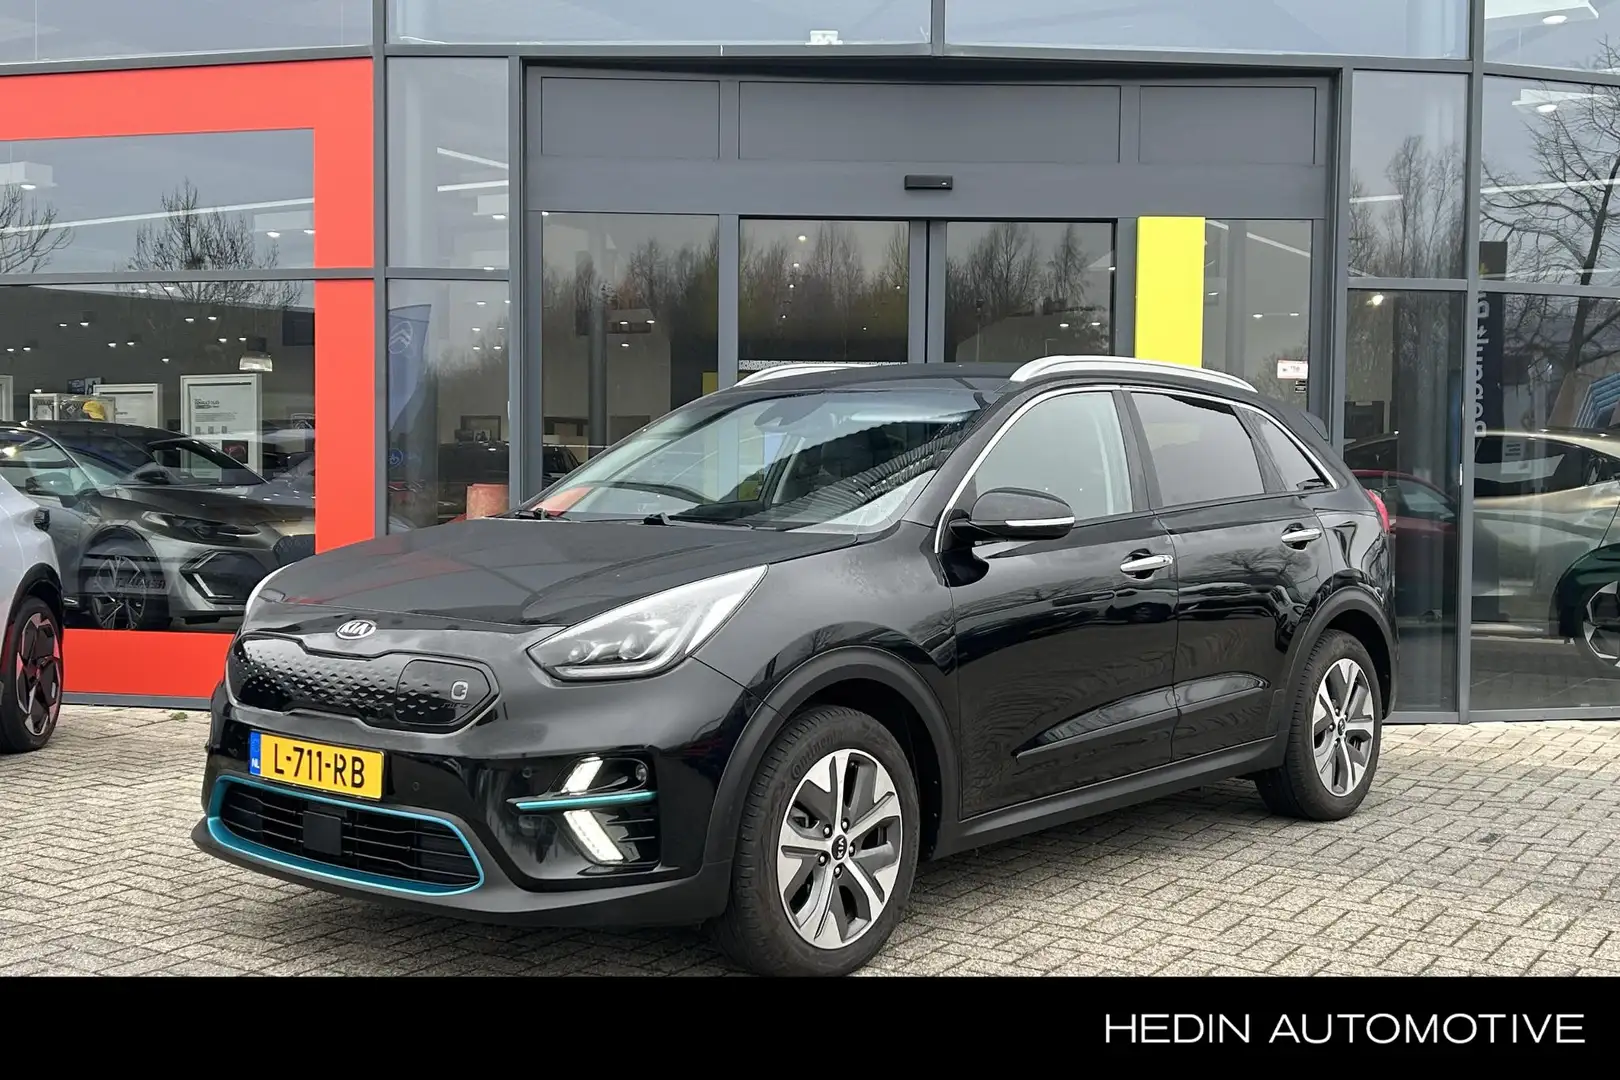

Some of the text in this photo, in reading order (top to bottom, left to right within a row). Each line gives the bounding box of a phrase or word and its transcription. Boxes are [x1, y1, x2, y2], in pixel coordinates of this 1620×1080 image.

[252, 757, 260, 768] NL
[274, 743, 365, 789] L-711-RB
[836, 837, 844, 858] KIA
